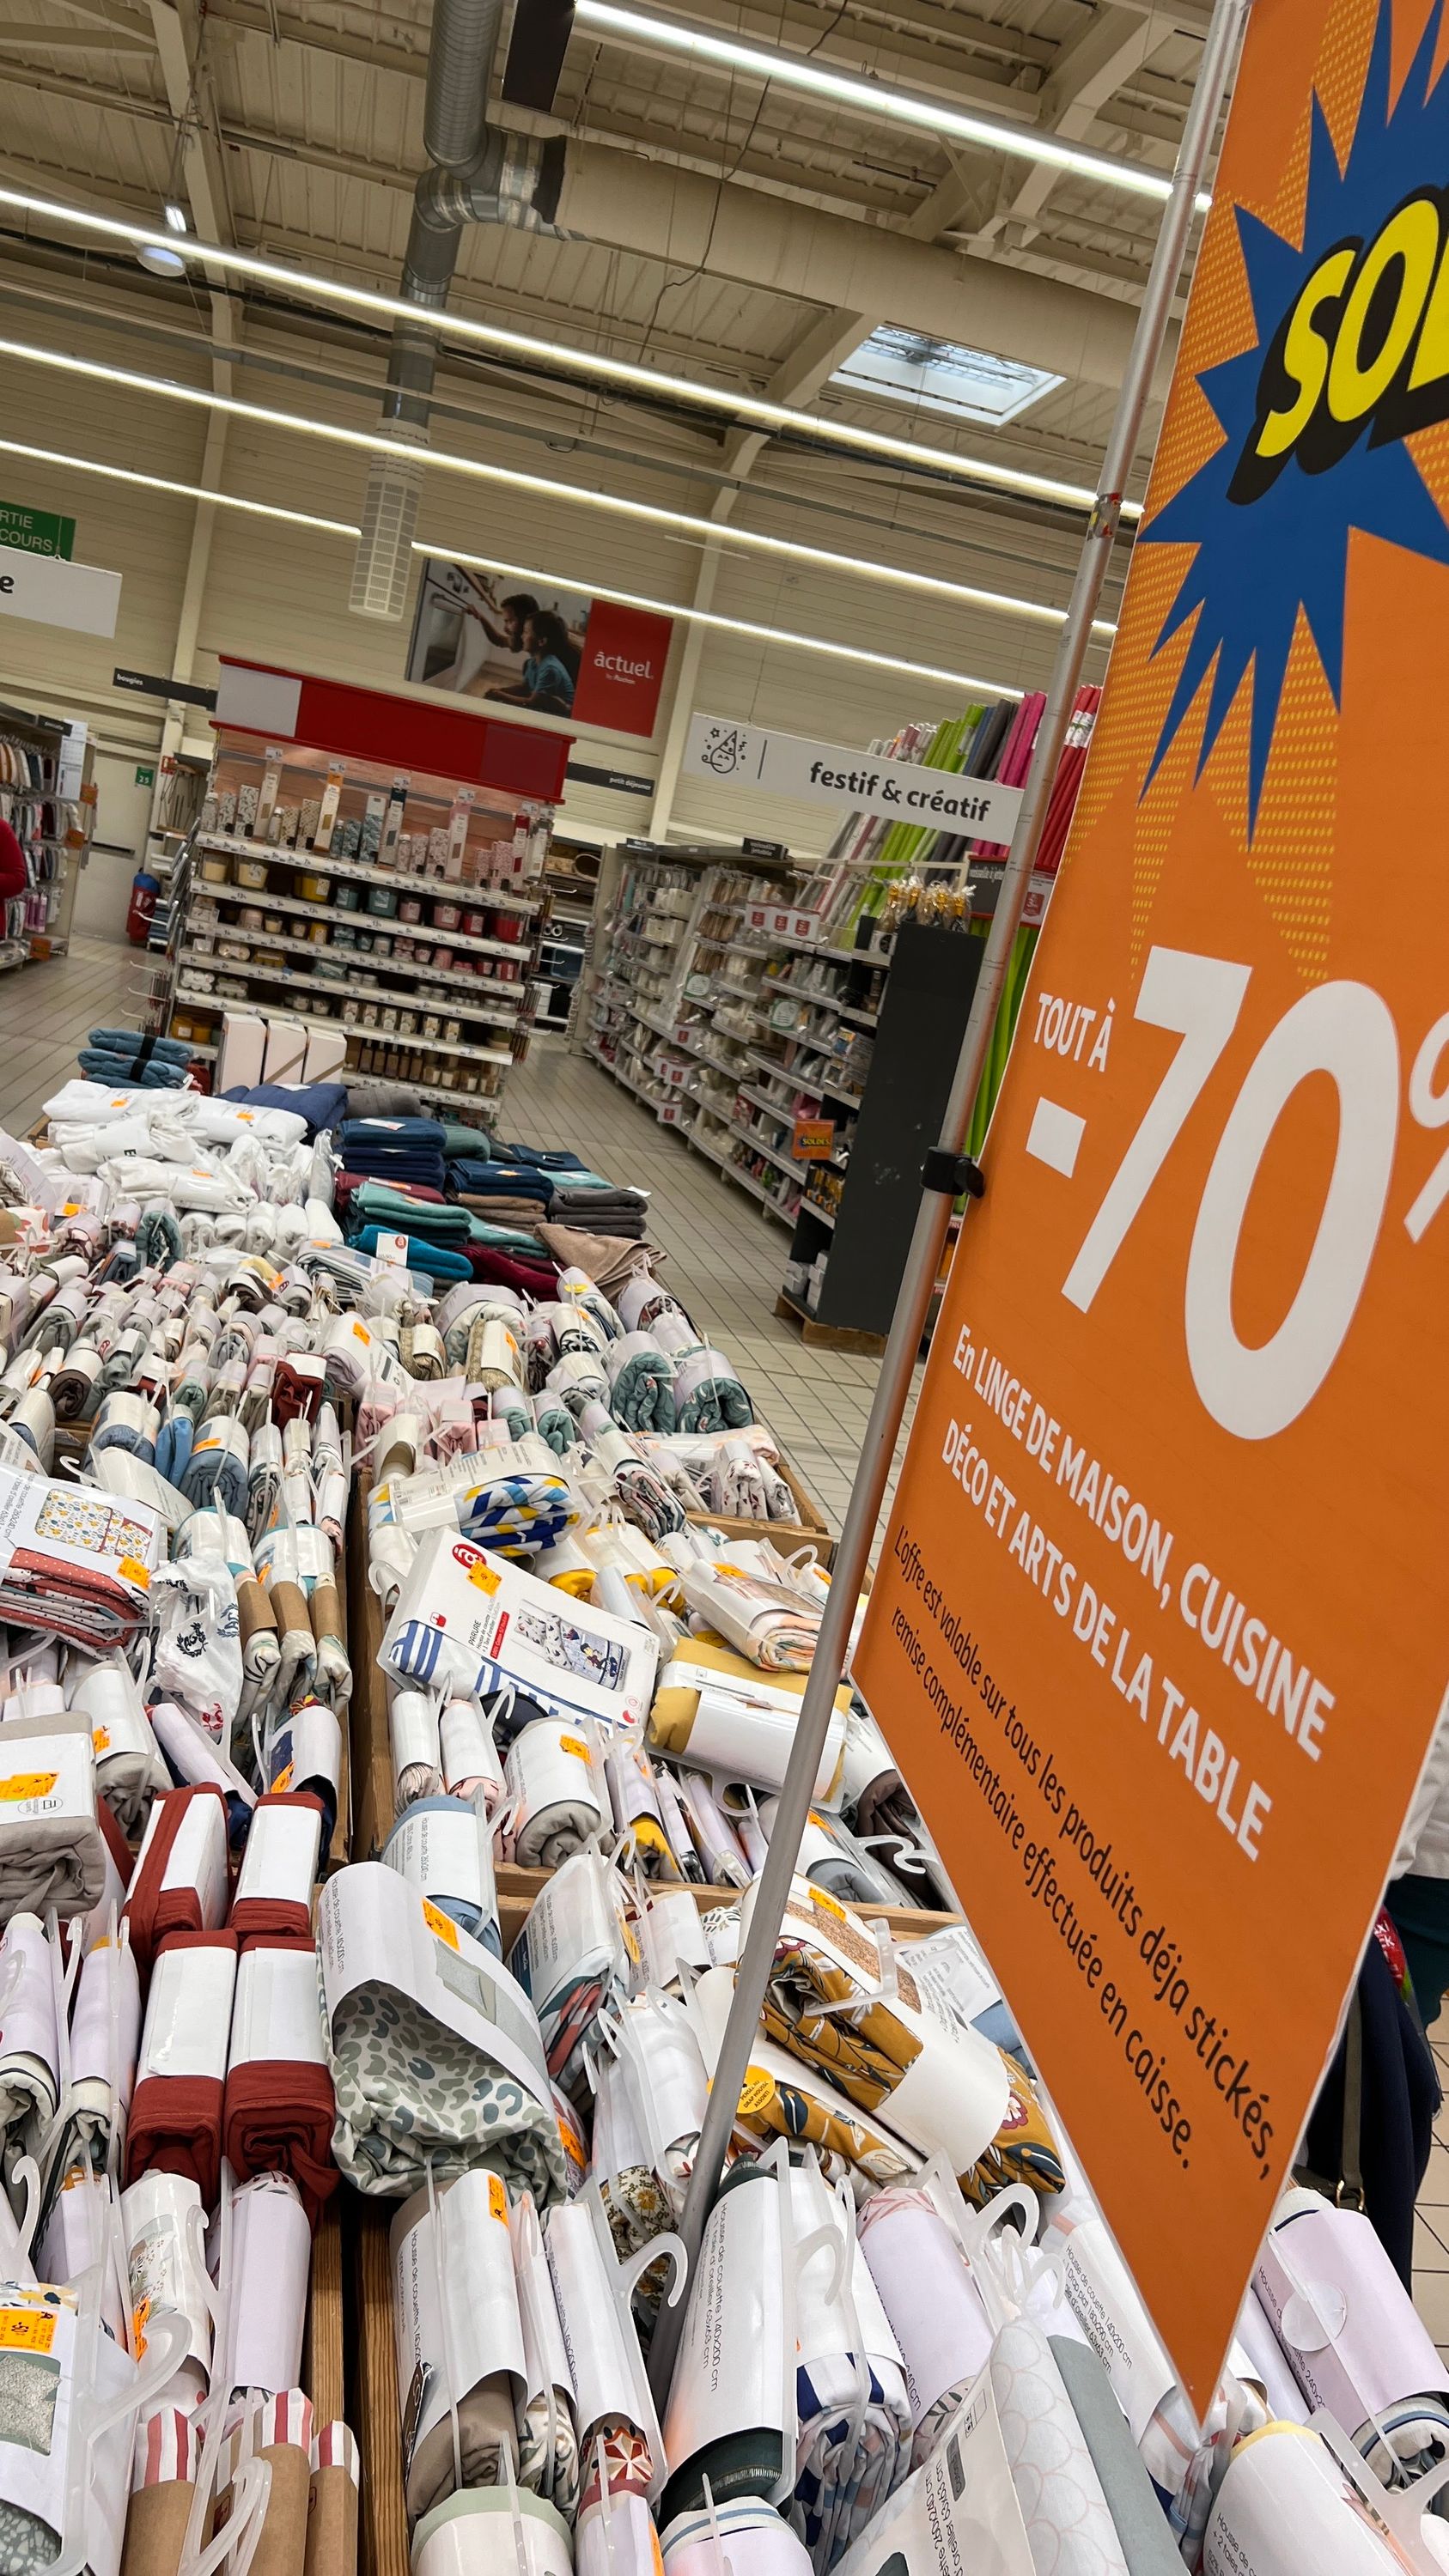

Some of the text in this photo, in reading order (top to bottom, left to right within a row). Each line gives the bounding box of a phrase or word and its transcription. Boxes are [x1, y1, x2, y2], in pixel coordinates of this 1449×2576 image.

[810, 761, 992, 822] festif & créatif
[1033, 993, 1116, 1072] TOUT À
[953, 1324, 1336, 1762] En LINGE DE MAISON, CUISINE
[468, 1619, 482, 1646] PARURE
[941, 1419, 1272, 1862] DÉCO ET ARTS DE LA TABLE
[894, 1525, 925, 1591] L'offre
[923, 1580, 943, 1619] est
[940, 1606, 982, 1686] valable
[979, 1674, 1008, 1720] sur
[1003, 1705, 1041, 1776] tous
[1037, 1753, 1066, 1814] les
[1058, 1803, 1142, 1937] produits
[1184, 2006, 1275, 2181] stickés,
[891, 1605, 1191, 2170] remise complémentaire effectuée en caisse.
[743, 2081, 769, 2109] DRAP HOUSSE
[754, 2090, 770, 2108] ASSORTI
[710, 2202, 728, 2392] Housse de couette 140x200 cm
[1066, 2245, 1133, 2370] Housse de couette 140x200 cm
[1258, 2265, 1277, 2309] Housse
[1067, 2268, 1080, 2293] Drap
[1077, 2290, 1089, 2309] plat
[1104, 2340, 1114, 2358] cm
[703, 2346, 709, 2369] cm
[1102, 2356, 1112, 2374] cm
[909, 2387, 922, 2411] cm
[925, 2470, 933, 2494] cm
[935, 2458, 944, 2482] cm
[926, 2493, 943, 2550] 260x240
[936, 2481, 951, 2521] 63x63
[1217, 2512, 1249, 2569] Housse de
[1222, 2543, 1238, 2573] taies
